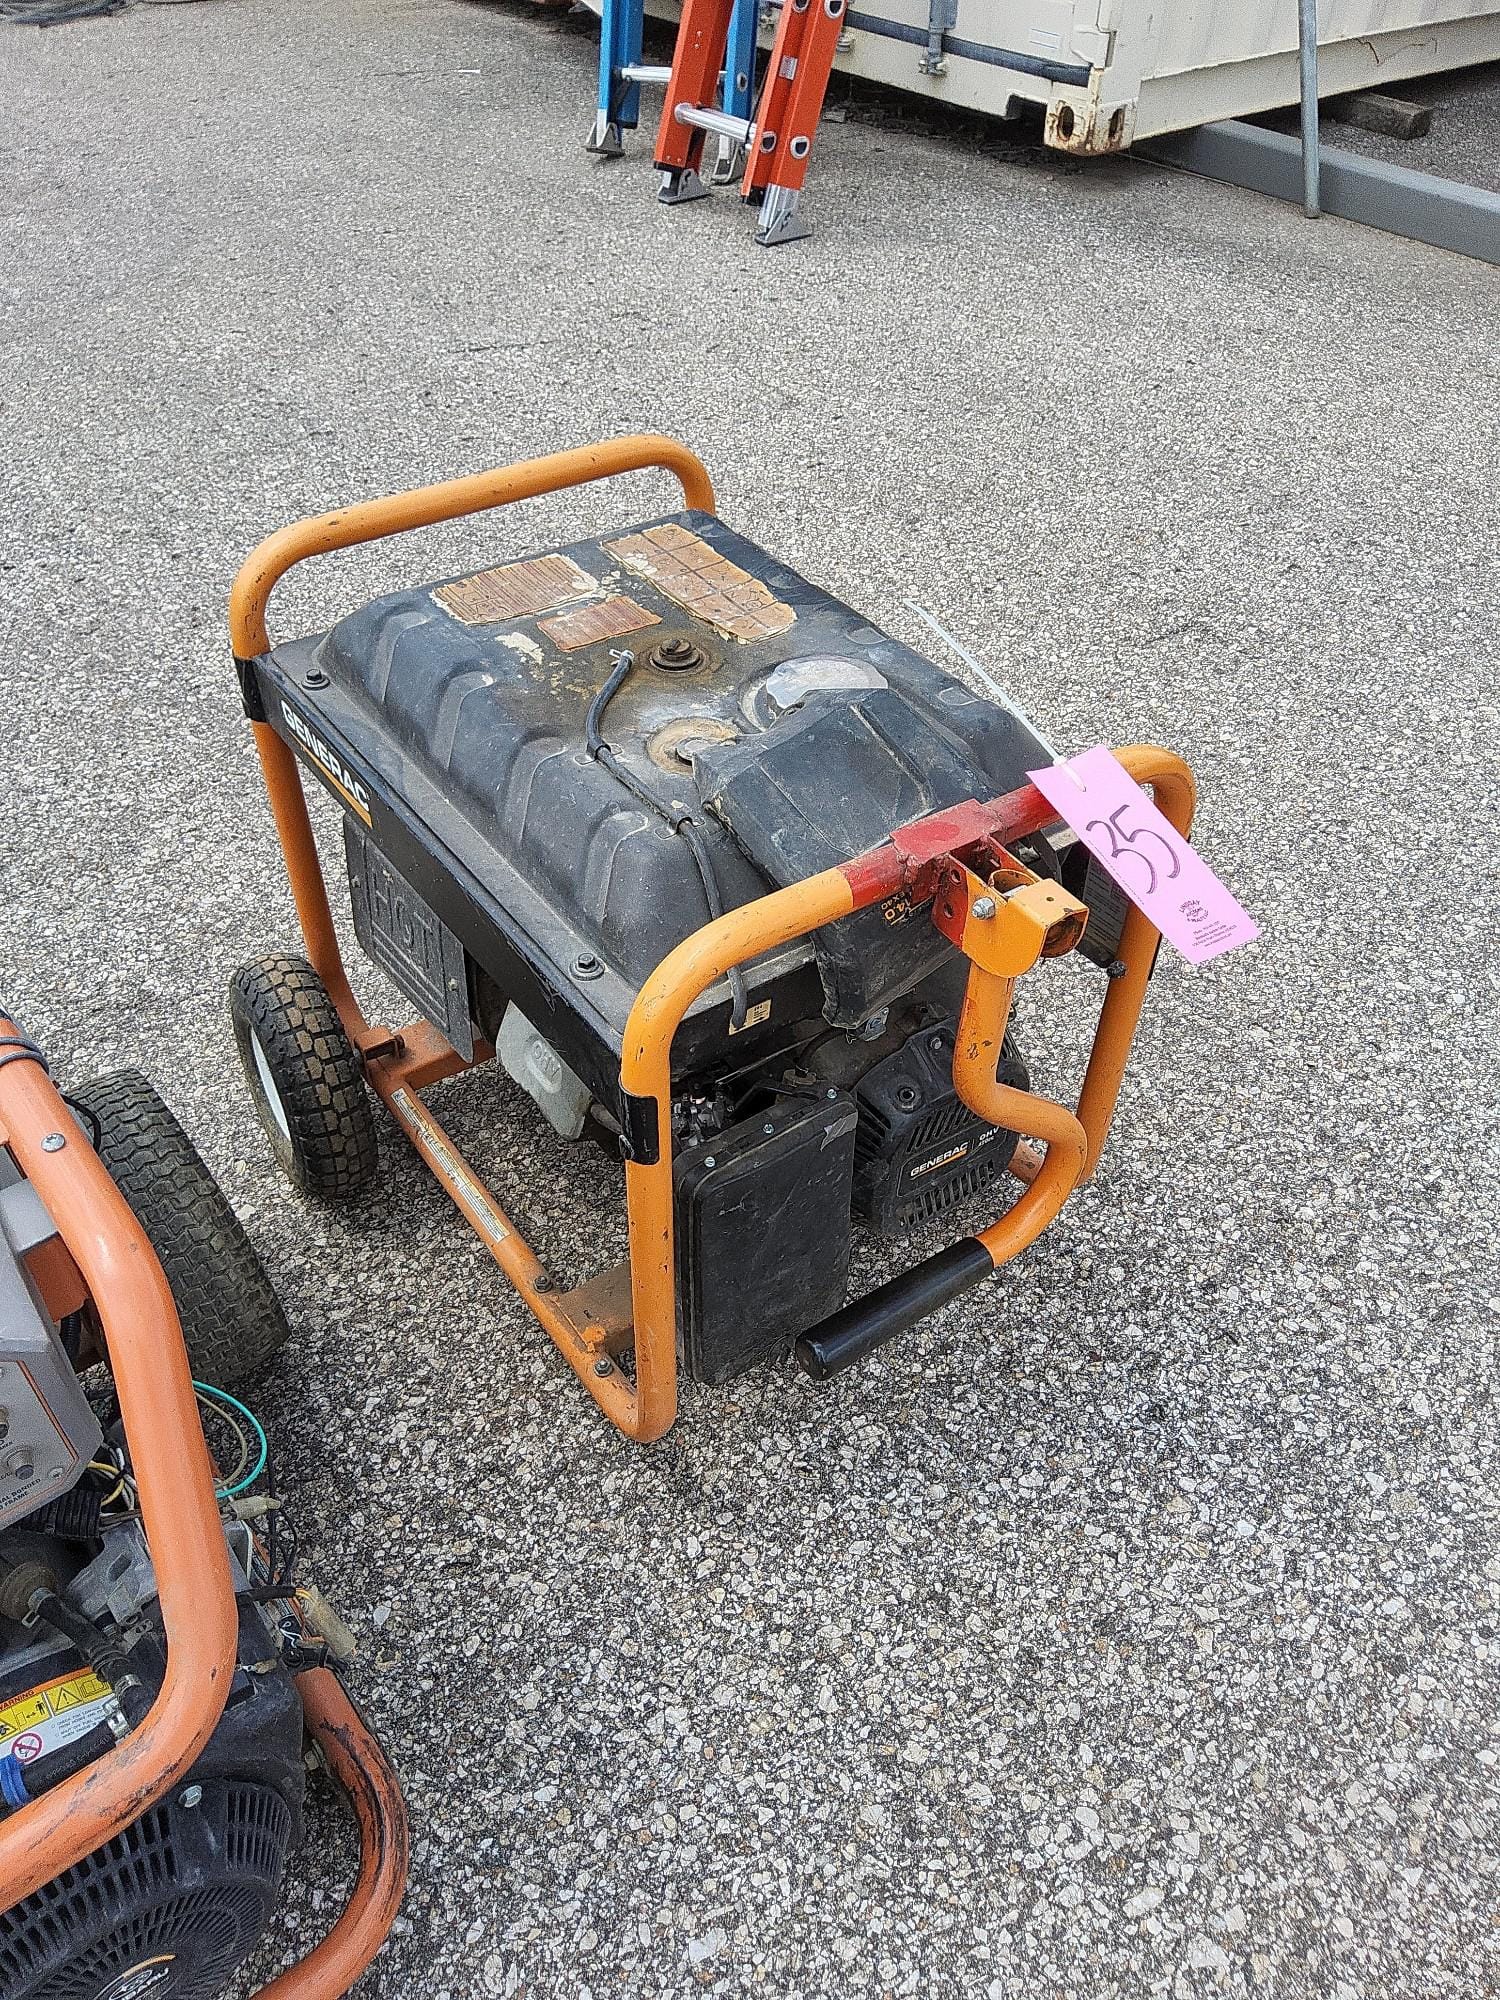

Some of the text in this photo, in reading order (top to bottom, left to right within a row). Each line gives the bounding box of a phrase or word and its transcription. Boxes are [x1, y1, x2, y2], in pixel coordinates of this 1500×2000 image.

[281, 700, 370, 812] GENERAC
[1085, 803, 1181, 895] 35
[910, 1125, 1000, 1177] GENERAC OHV
